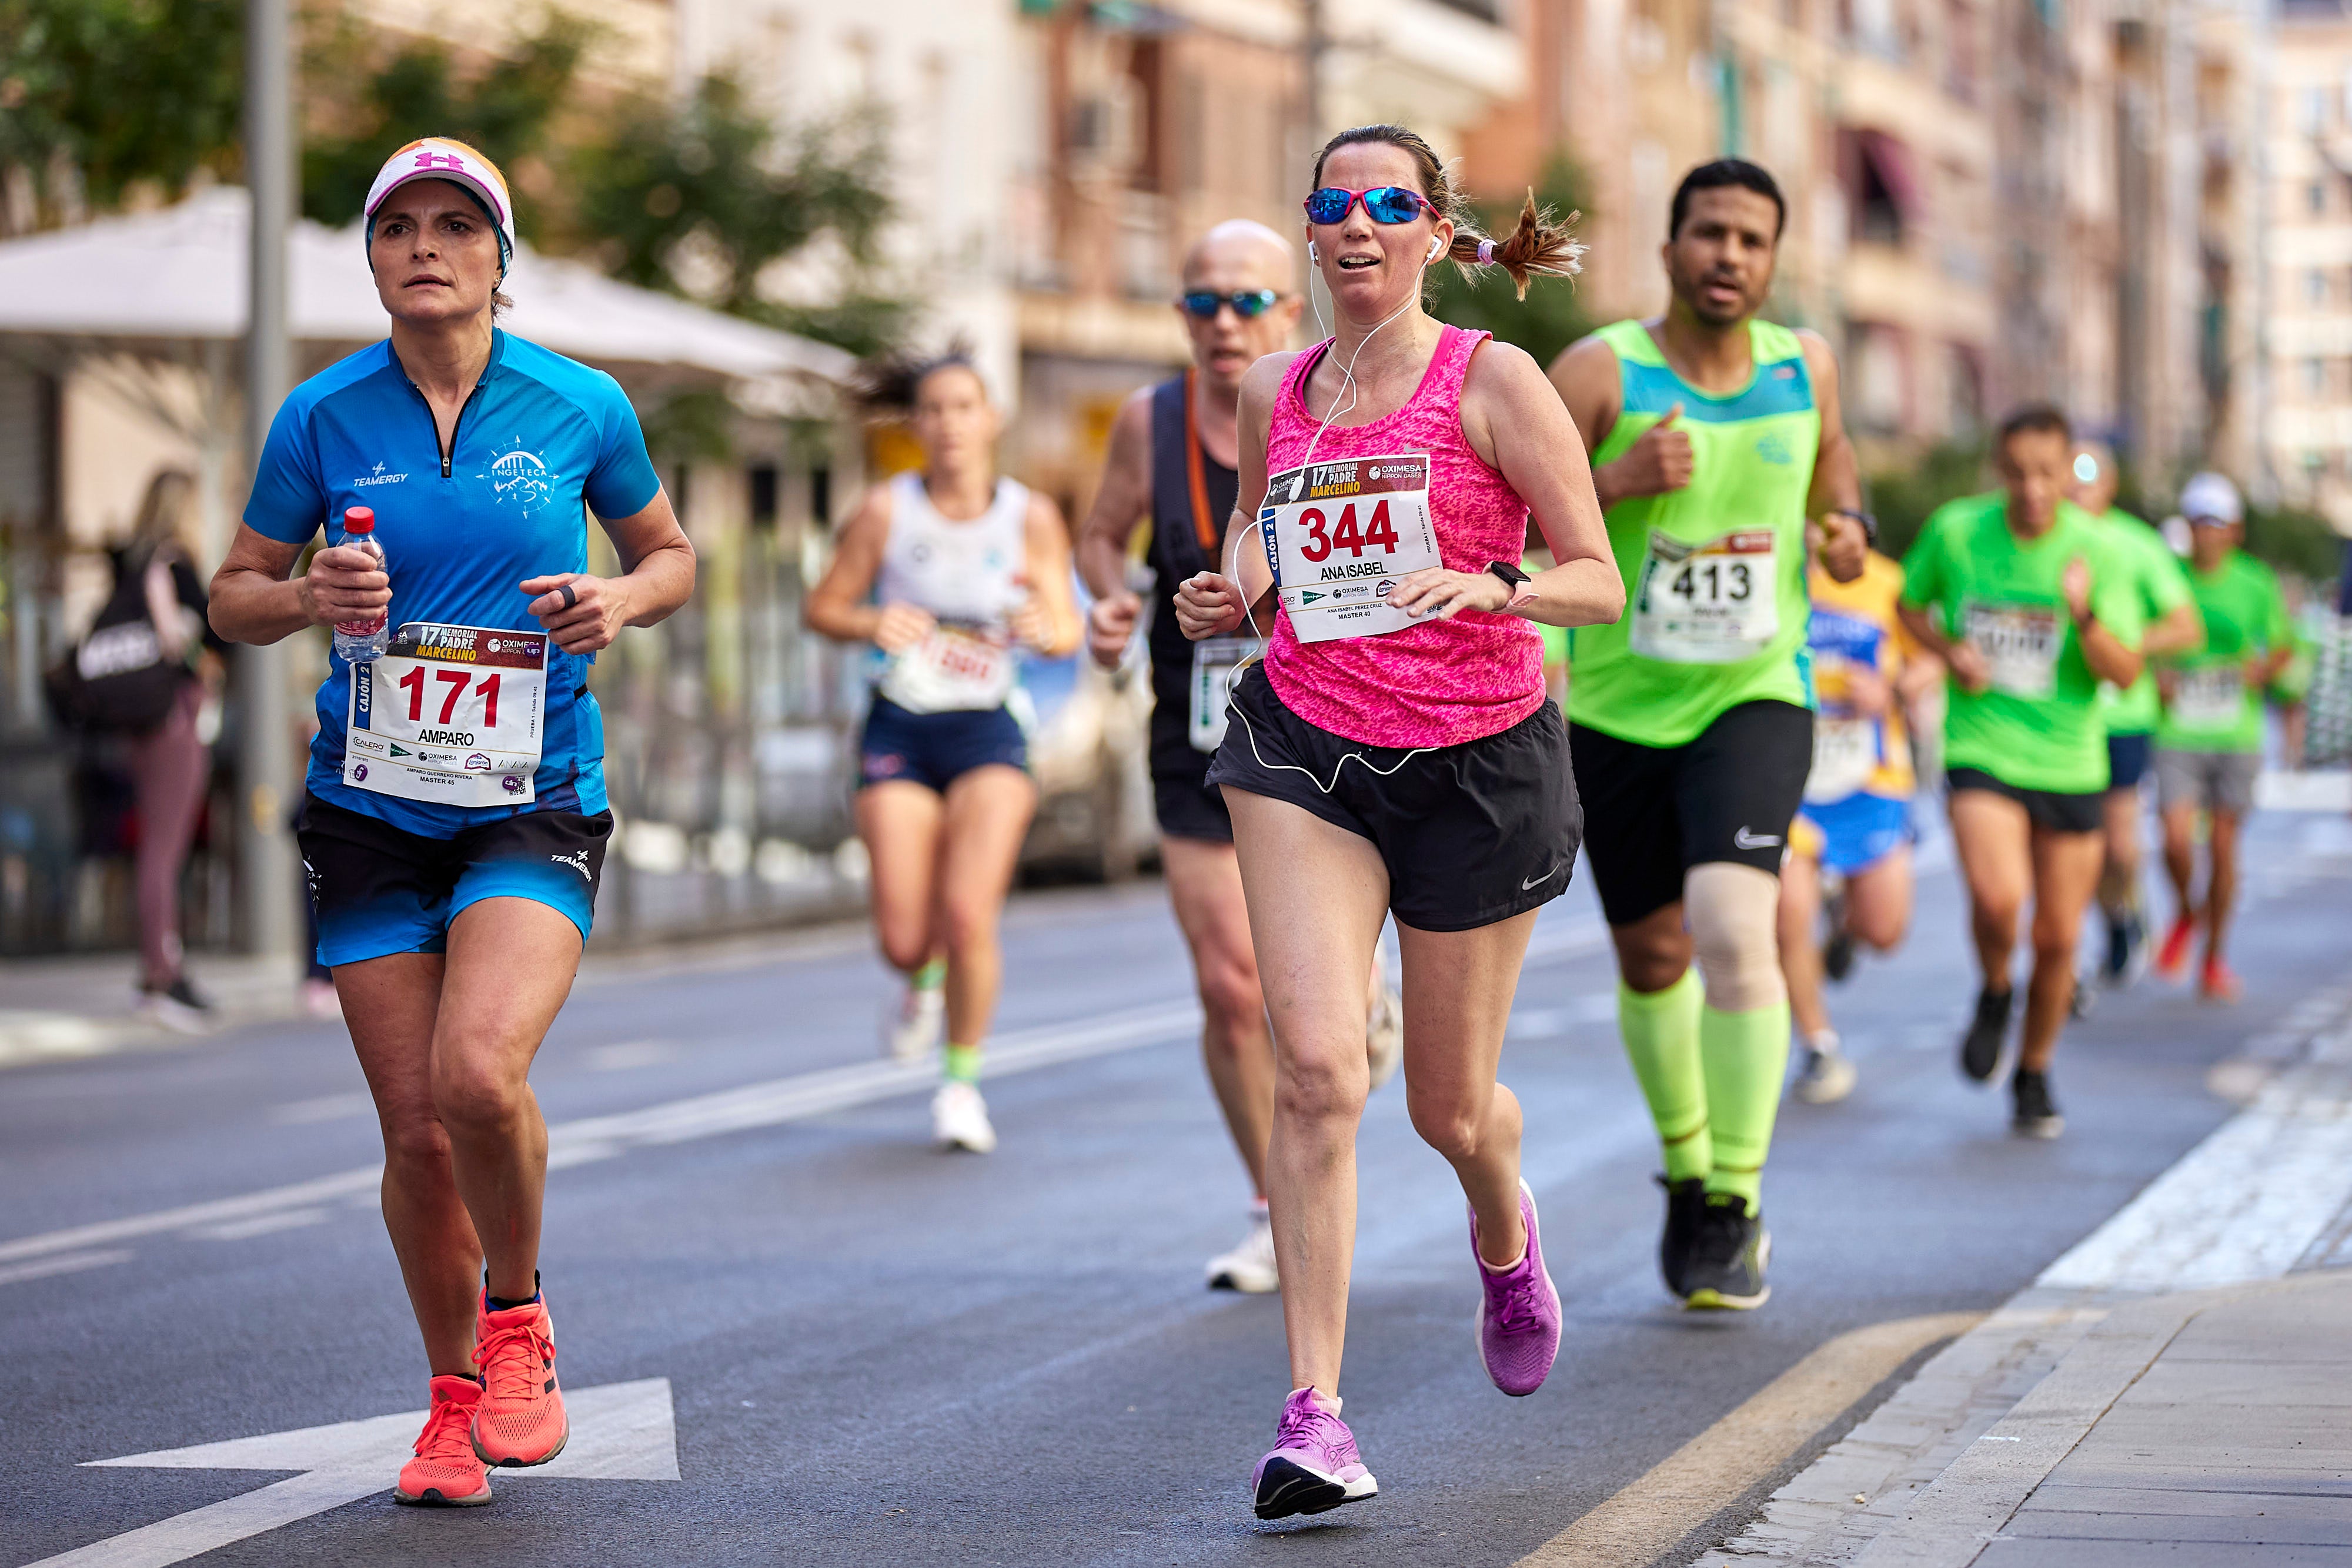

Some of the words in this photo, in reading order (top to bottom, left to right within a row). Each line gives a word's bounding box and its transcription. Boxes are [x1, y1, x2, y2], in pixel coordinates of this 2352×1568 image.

[354, 473, 408, 487] TEAMERGY
[1279, 477, 1295, 488] OXIME
[1312, 466, 1328, 486] 17
[1328, 462, 1358, 473] MEMORIAL
[1328, 471, 1356, 484] PADRE
[1309, 481, 1360, 497] MARCELINO
[1298, 499, 1399, 562] 344
[1267, 534, 1278, 571] CAJÓN
[1321, 566, 1346, 581] ANA
[1346, 561, 1388, 577] ISABEL
[1672, 563, 1750, 600] 413
[1338, 611, 1363, 620] MASTER
[420, 626, 442, 646] 17
[440, 628, 477, 639] MEMORIAL
[440, 636, 475, 650] PADRE
[416, 645, 477, 661] MARCELINO
[360, 666, 369, 674] 2
[358, 677, 369, 713] CAJÓN
[400, 666, 500, 728] 171
[355, 738, 383, 750] CALERO
[418, 729, 474, 746] AMPARO
[551, 854, 592, 882] TEAMERGY
